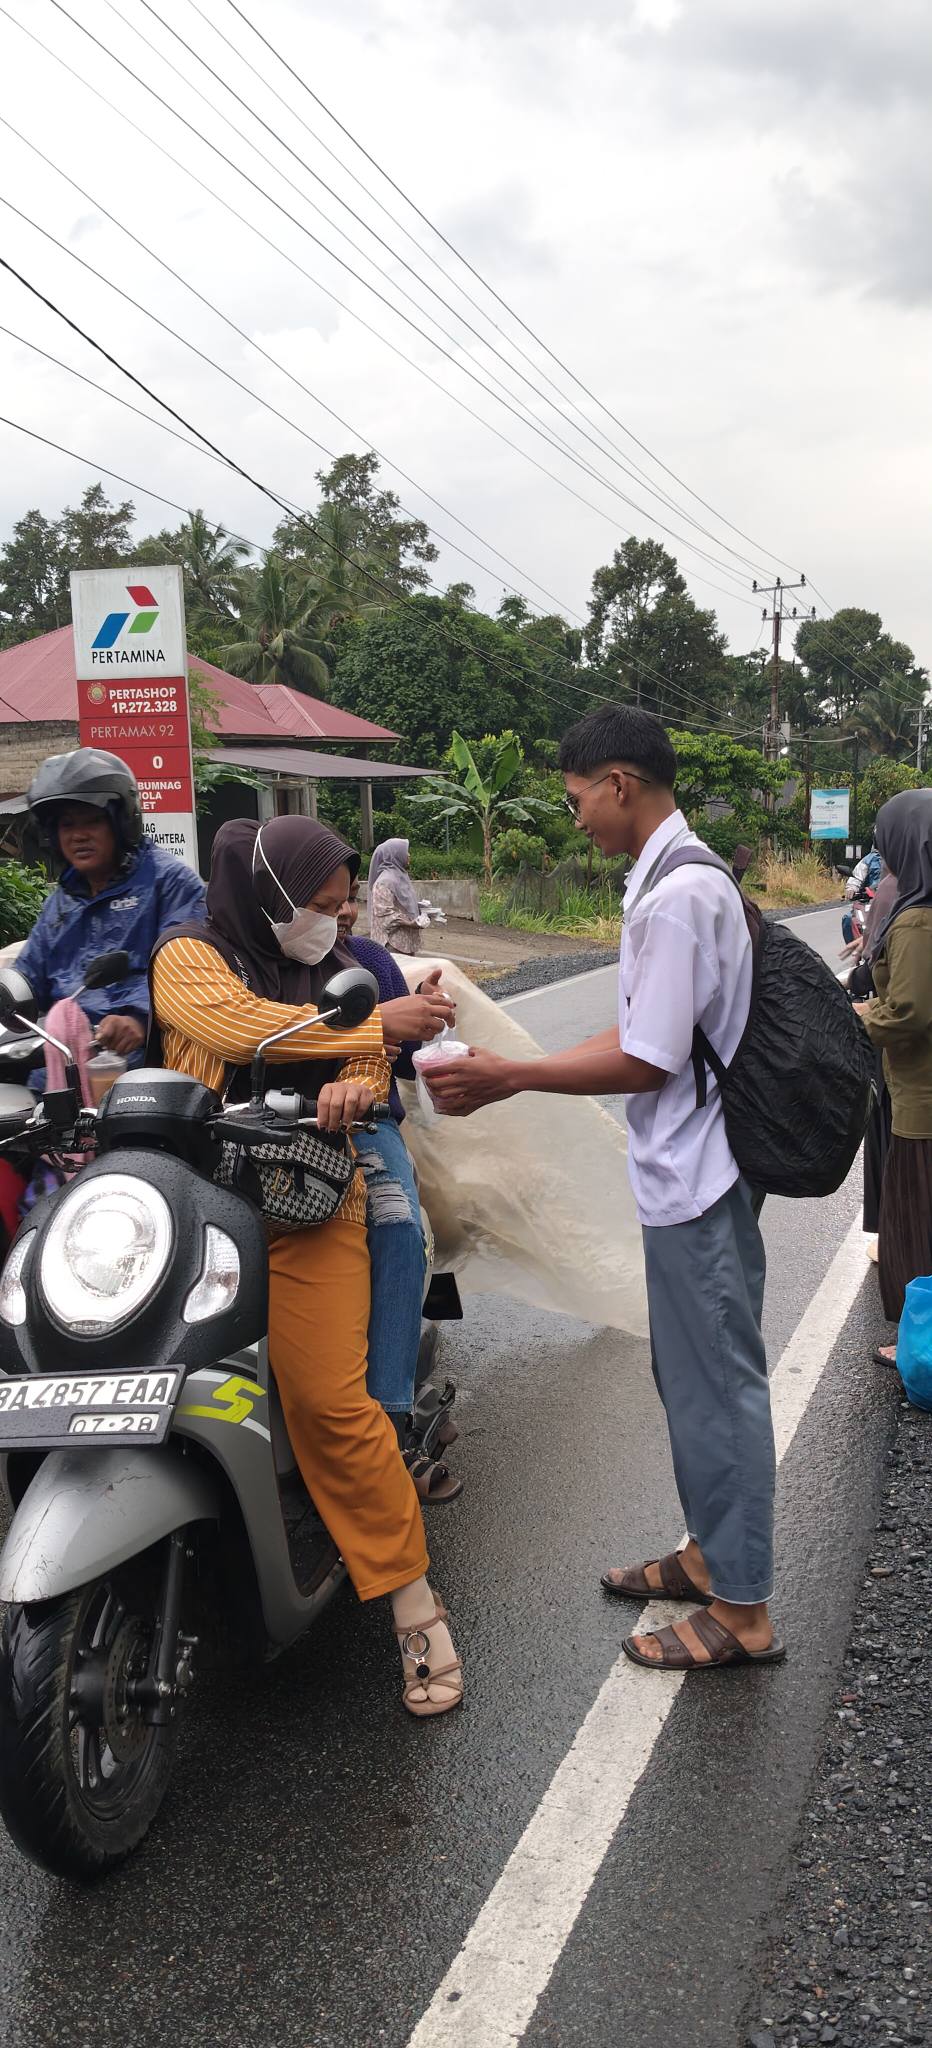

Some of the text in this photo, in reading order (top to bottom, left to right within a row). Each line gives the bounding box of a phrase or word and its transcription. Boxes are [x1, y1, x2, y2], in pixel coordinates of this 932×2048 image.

[92, 649, 165, 664] PERTAMINA
[109, 687, 176, 700] PERTASHOP
[111, 700, 177, 713] 1P.272.328
[91, 724, 175, 739] PERTAMAX 92
[152, 755, 163, 769] 0
[137, 781, 181, 790] BUMNAG
[140, 801, 156, 810] ET
[116, 1095, 157, 1105] HONDA
[32, 1381, 107, 1408] 4857
[112, 1377, 169, 1404] EAA
